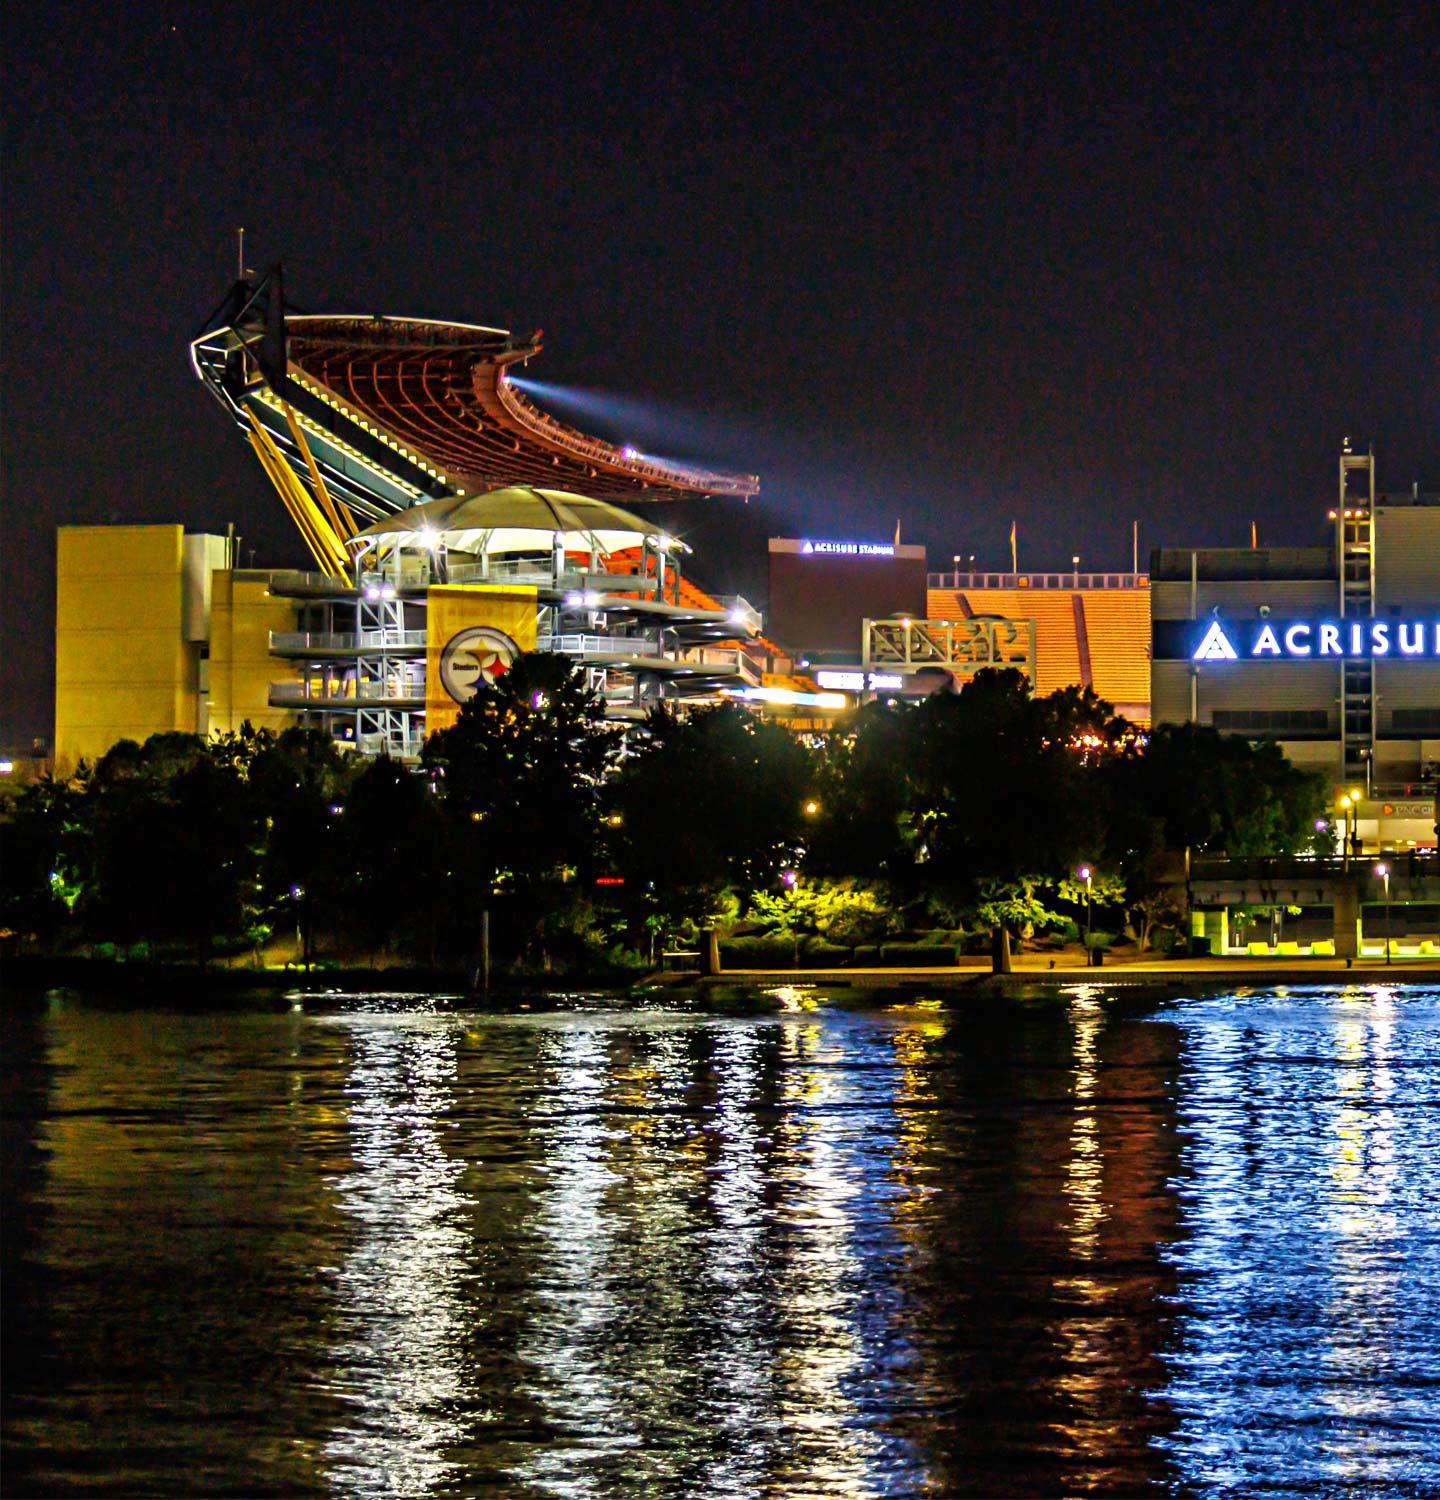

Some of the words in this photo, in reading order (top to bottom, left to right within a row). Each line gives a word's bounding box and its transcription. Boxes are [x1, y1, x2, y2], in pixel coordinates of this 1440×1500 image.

[815, 542, 858, 553] ACRISURE
[859, 544, 894, 554] STADIUM
[452, 662, 478, 670] Steelers
[1395, 805, 1419, 816] PNC
